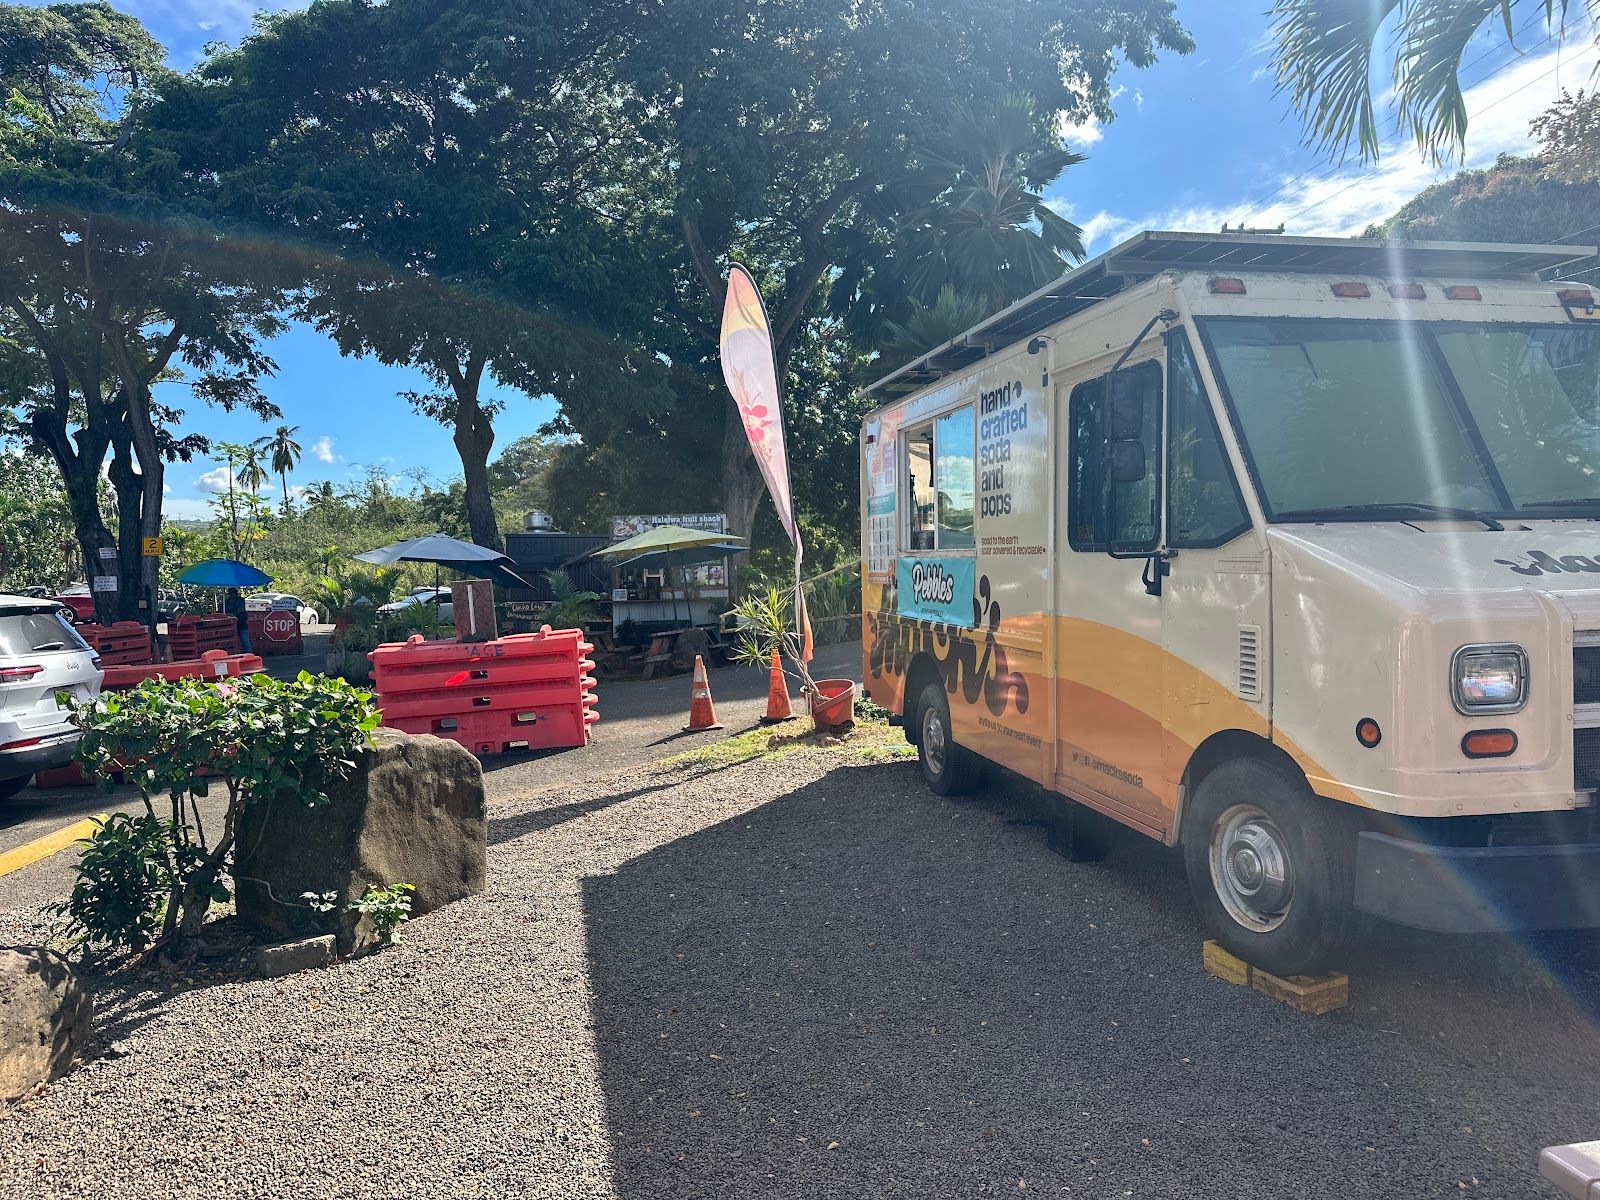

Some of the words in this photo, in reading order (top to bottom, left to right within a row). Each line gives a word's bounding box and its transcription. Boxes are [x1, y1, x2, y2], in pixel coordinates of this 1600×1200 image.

[981, 381, 1011, 416] hand
[981, 403, 1028, 441] crafted
[981, 438, 1011, 467] soda
[981, 464, 1004, 492] and
[981, 492, 1012, 518] pops
[683, 515, 698, 523] fruit
[700, 514, 721, 523] shack
[149, 539, 157, 549] 2
[981, 537, 992, 546] good
[992, 536, 998, 545] to
[997, 536, 1006, 545] the
[1005, 535, 1019, 545] earth
[981, 547, 992, 556] solar
[992, 546, 1013, 555] powered
[1016, 545, 1043, 556] recyclable
[911, 560, 955, 605] Pebbles
[266, 619, 295, 632] STOP
